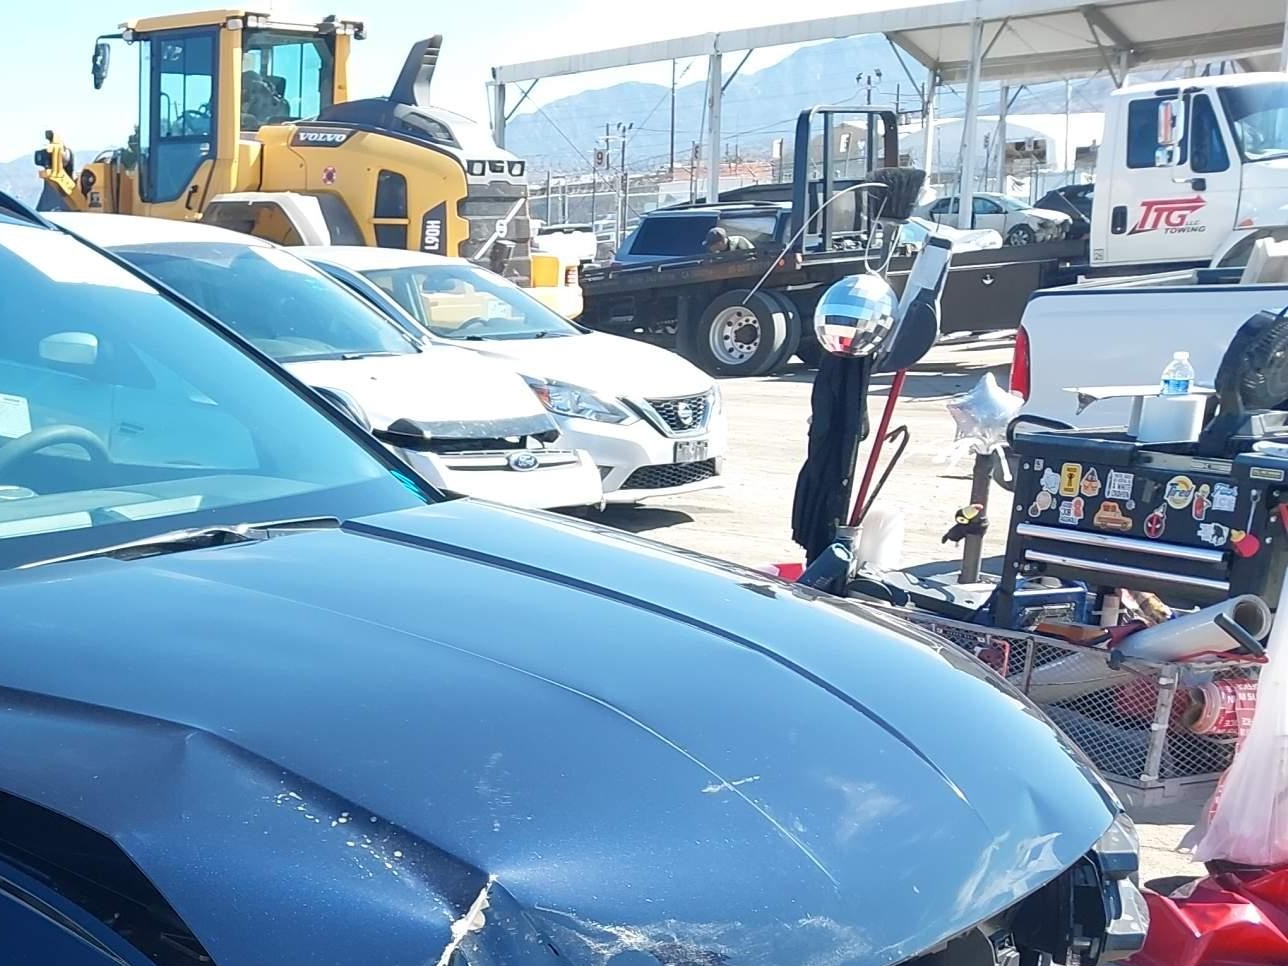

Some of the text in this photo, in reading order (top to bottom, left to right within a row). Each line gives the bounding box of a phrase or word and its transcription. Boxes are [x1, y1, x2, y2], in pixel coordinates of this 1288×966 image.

[299, 132, 347, 142] VOLVO
[596, 151, 604, 166] 9
[424, 220, 441, 250] L90H
[1164, 225, 1207, 235] TOWING
